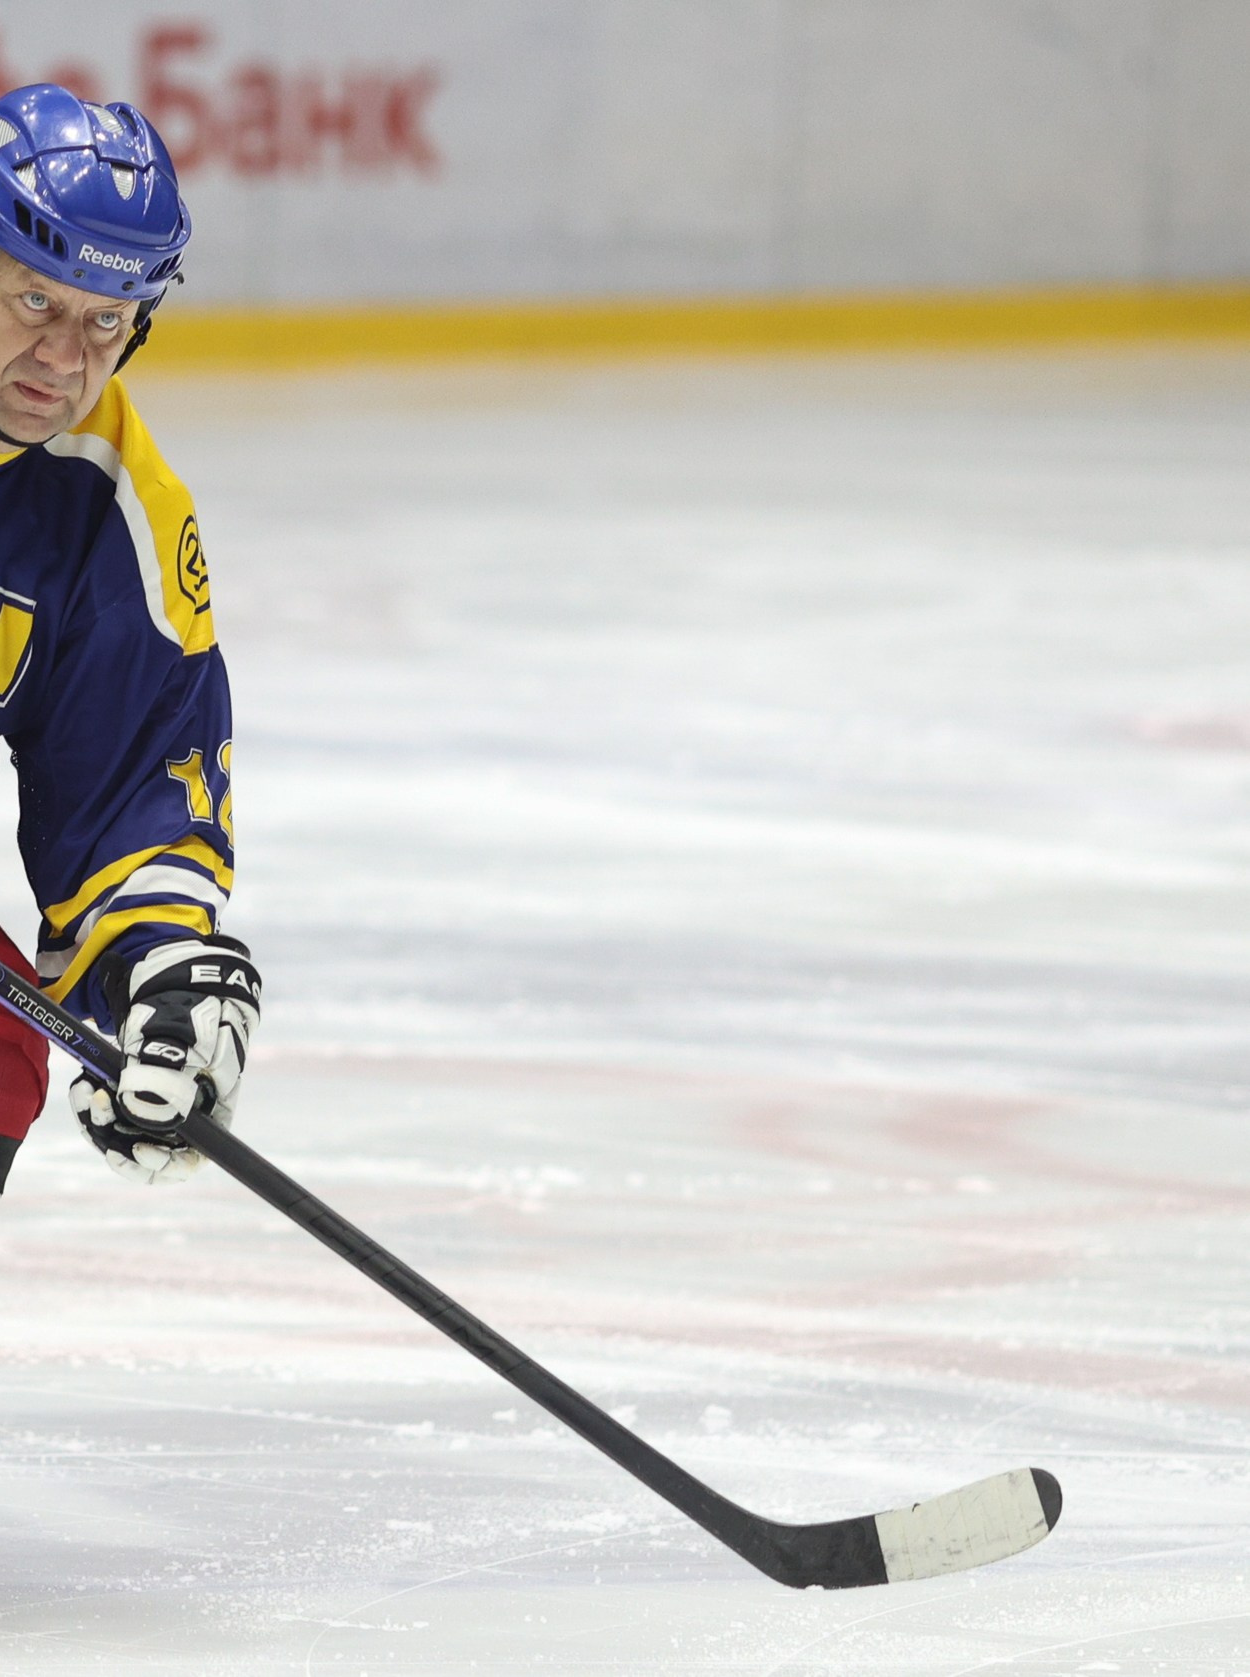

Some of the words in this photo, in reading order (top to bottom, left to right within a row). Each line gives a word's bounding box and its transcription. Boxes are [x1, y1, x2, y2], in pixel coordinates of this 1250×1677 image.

[78, 243, 146, 275] Reebok
[7, 984, 74, 1040] TRIGGER
[71, 1033, 84, 1046] 7
